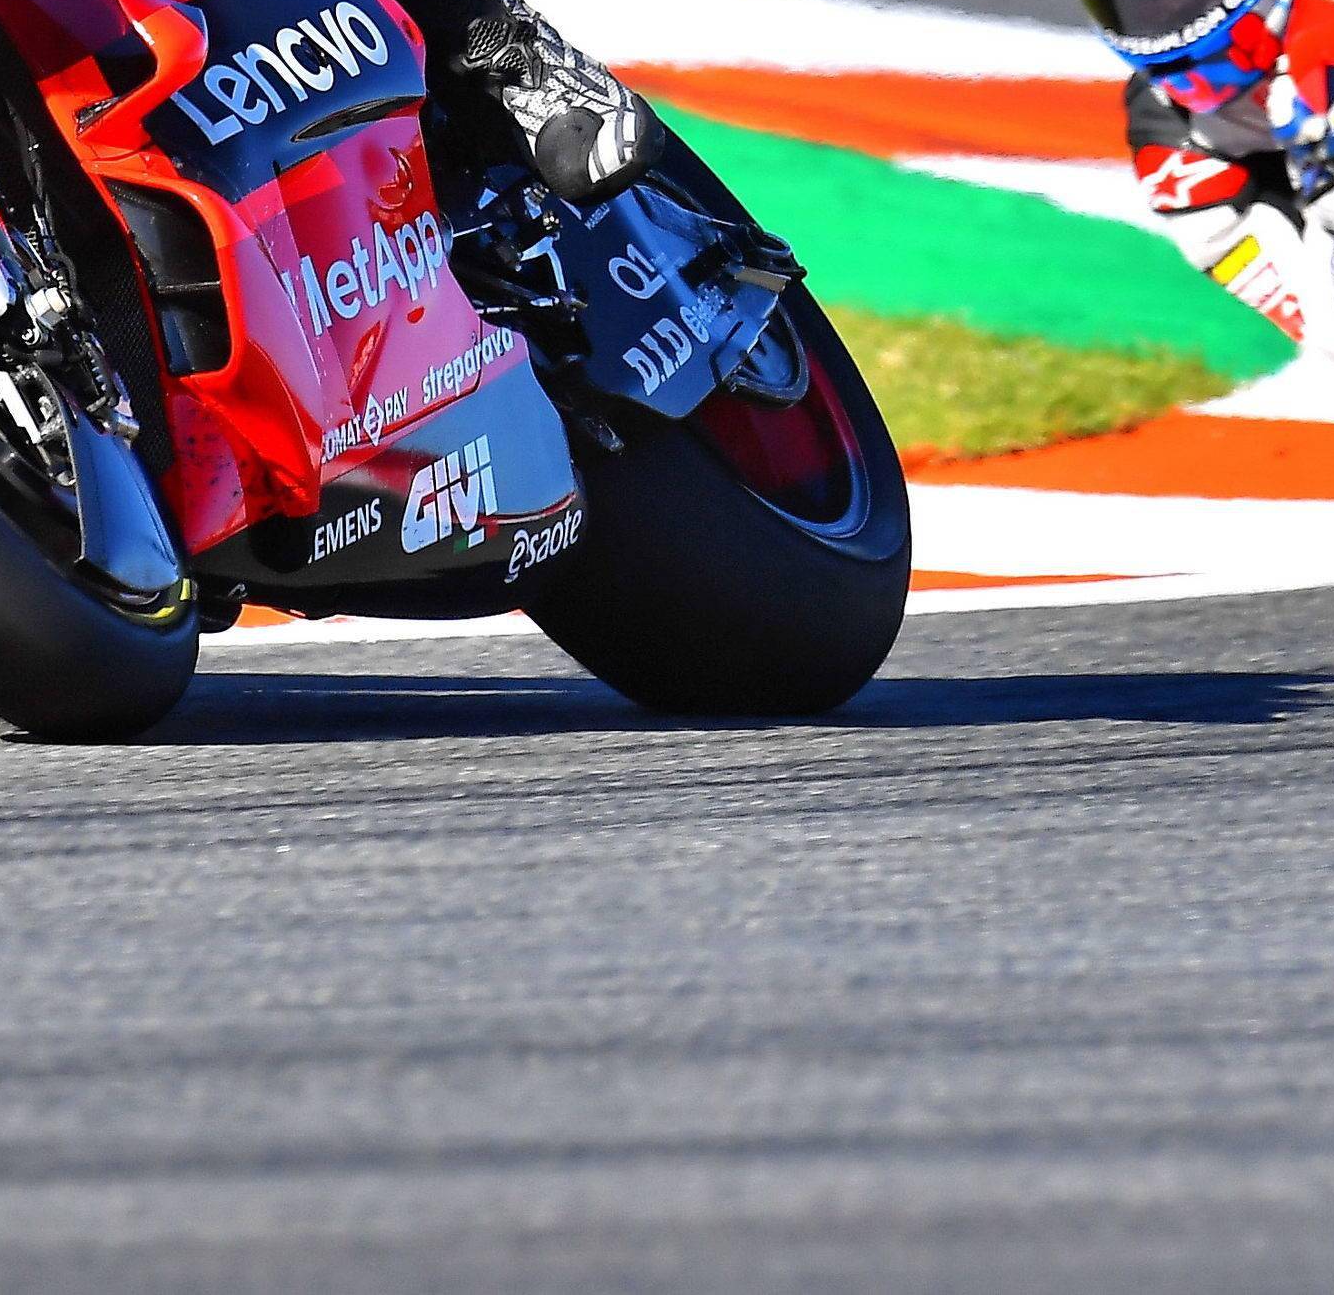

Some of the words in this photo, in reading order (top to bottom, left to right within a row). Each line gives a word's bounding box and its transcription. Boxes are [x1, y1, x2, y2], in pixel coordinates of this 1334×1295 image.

[170, 1, 388, 146] Lenovo
[422, 327, 514, 404] streparava
[321, 412, 362, 464] OMAT
[384, 387, 409, 425] PAY
[308, 497, 383, 565] EMENS
[400, 433, 499, 554] GIVI
